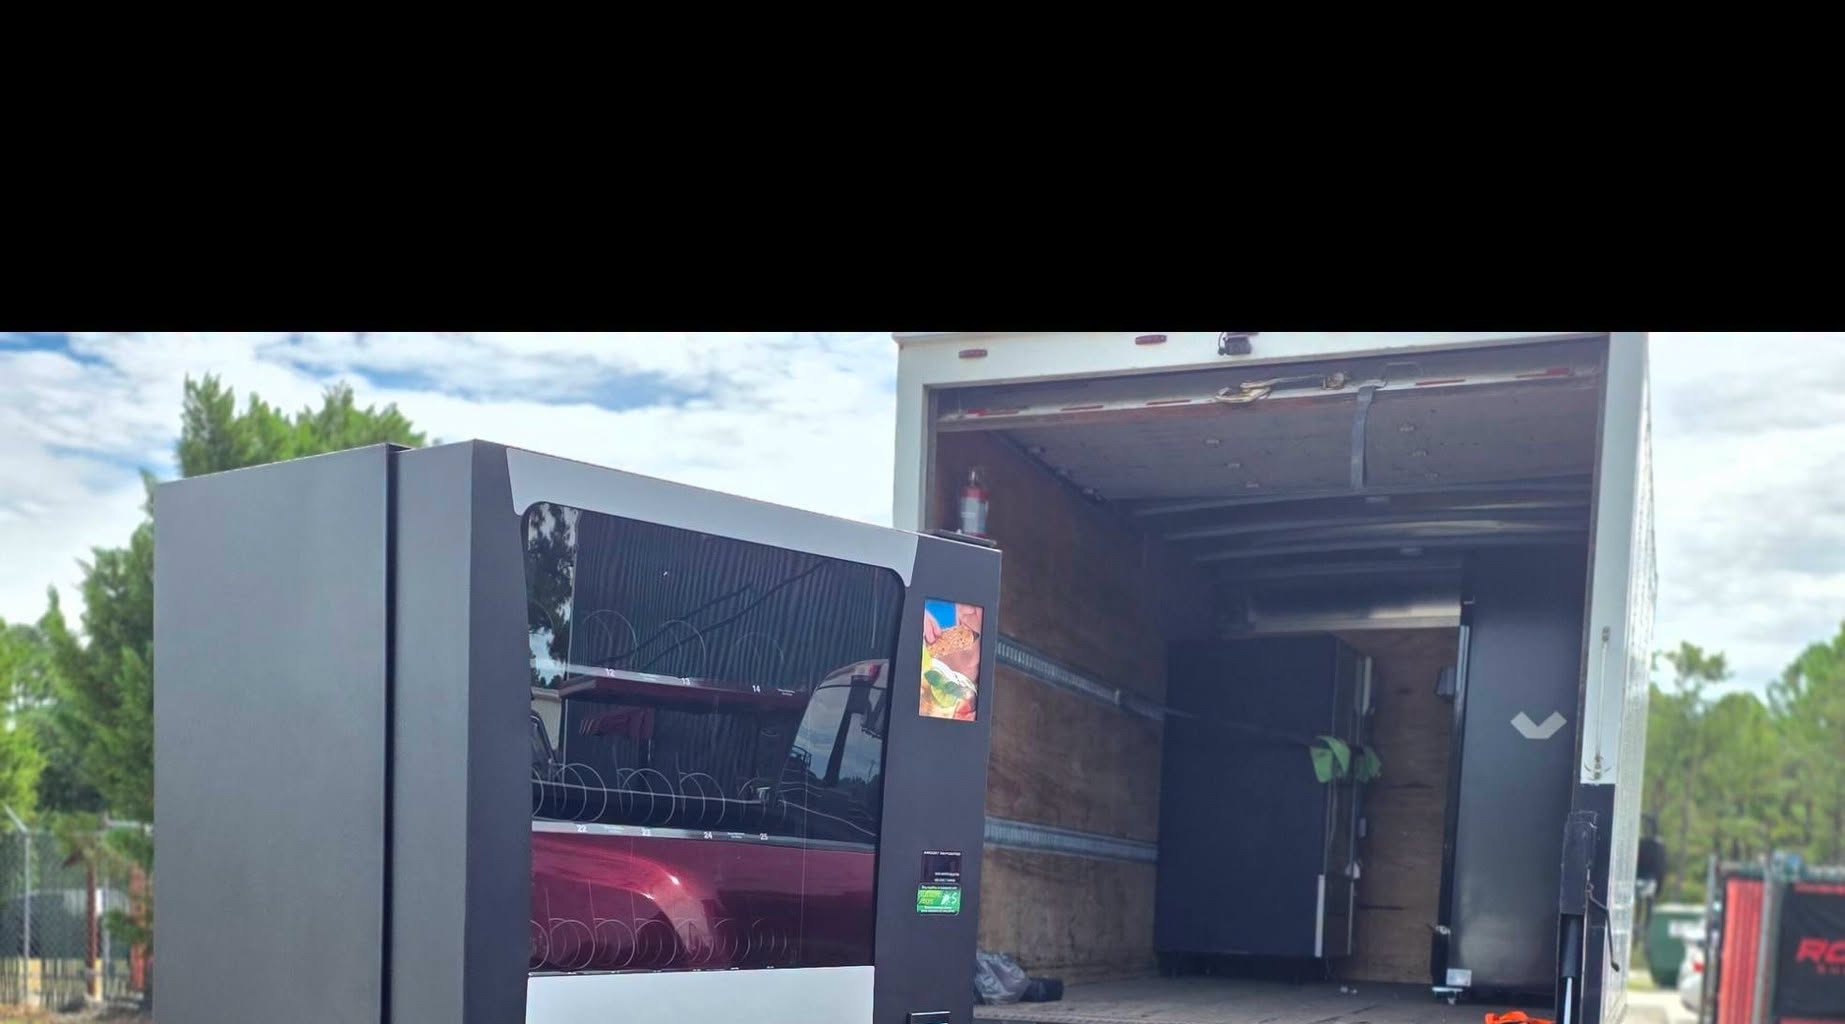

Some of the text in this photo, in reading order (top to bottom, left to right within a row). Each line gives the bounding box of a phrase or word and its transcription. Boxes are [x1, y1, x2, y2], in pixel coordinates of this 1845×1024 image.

[605, 667, 616, 678] 12
[752, 684, 761, 693] 14
[576, 823, 588, 833] 22
[703, 831, 713, 840] 24
[759, 832, 769, 841] 25
